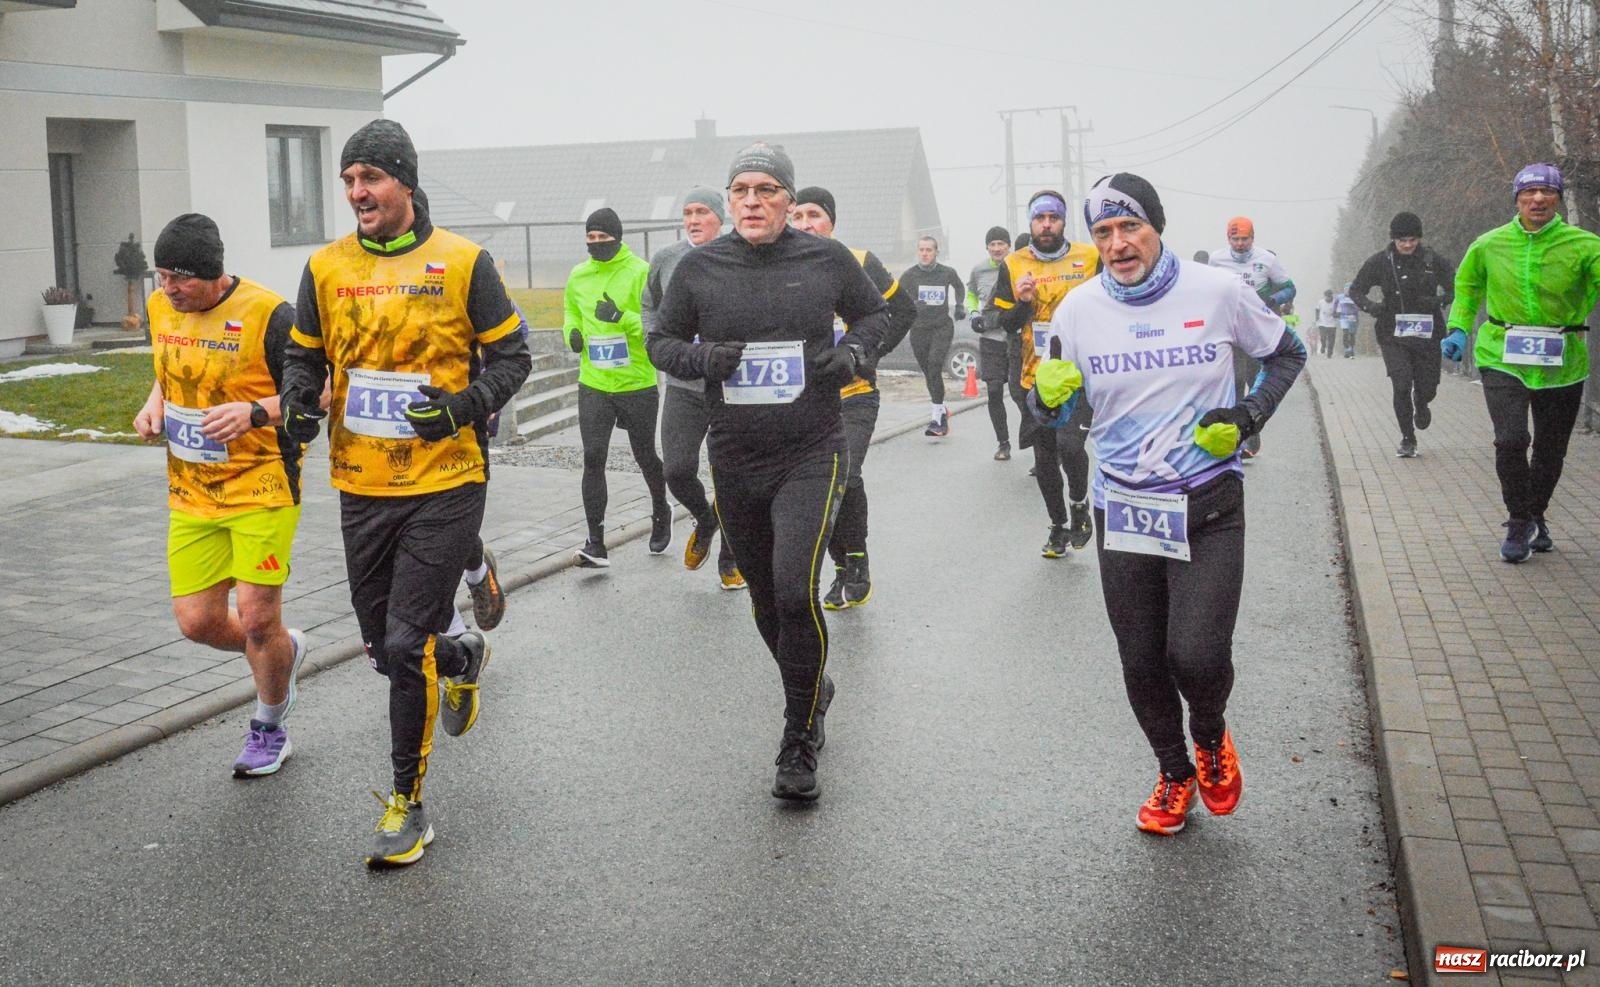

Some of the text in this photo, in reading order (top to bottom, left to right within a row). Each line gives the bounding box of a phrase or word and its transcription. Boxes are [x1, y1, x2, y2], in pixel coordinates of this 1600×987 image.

[1406, 321, 1423, 332] 26
[597, 345, 615, 360] 17
[1088, 342, 1217, 375] RUNNERS
[1521, 337, 1547, 355] 31
[736, 359, 789, 386] 178
[359, 389, 413, 421] 113
[177, 424, 204, 449] 45
[1121, 506, 1172, 539] 194
